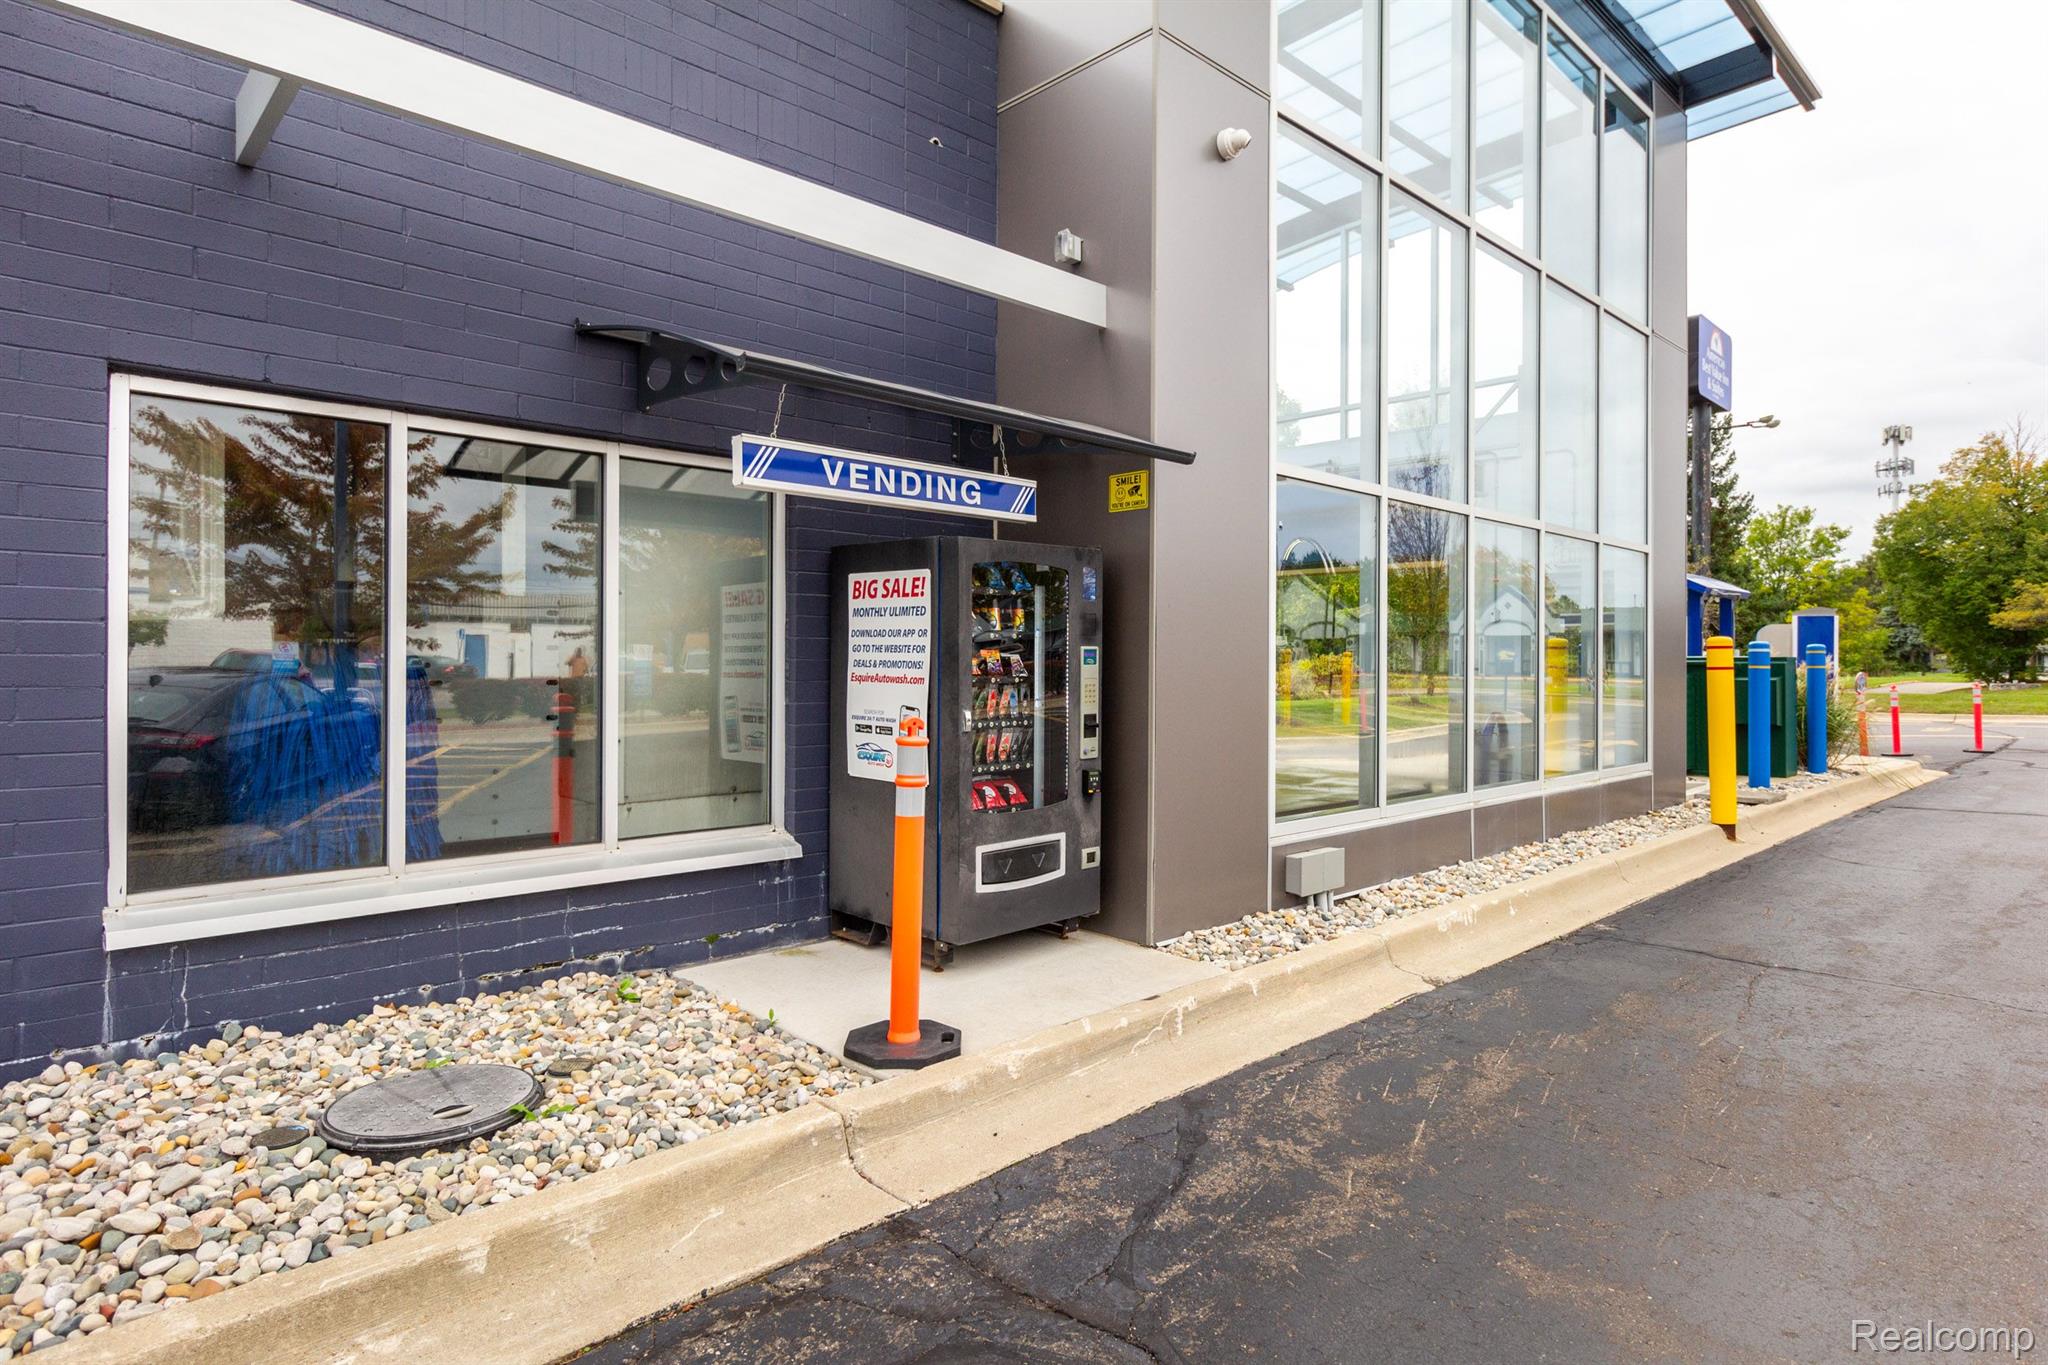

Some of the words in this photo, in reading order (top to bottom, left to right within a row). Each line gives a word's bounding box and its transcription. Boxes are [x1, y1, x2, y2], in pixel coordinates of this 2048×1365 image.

[821, 458, 982, 505] VENDING
[1115, 475, 1141, 486] SMILE!
[852, 580, 878, 599] BIG
[881, 577, 926, 598] SALE!
[852, 607, 888, 617] MONTHLY
[889, 606, 926, 616] ULIMITED
[851, 629, 887, 638] DOWNLOAD
[887, 628, 902, 638] OUR
[902, 628, 916, 638] APP
[917, 628, 928, 638] OR
[852, 644, 862, 653] GO
[862, 644, 871, 653] TO
[871, 644, 883, 653] THE
[884, 644, 911, 653] WEBSITE
[912, 644, 926, 653] FOR
[853, 659, 872, 668] DEALS
[872, 660, 877, 668] &
[878, 660, 924, 669] PROMOTIONS!
[850, 672, 925, 685] EsquireAutowash.com
